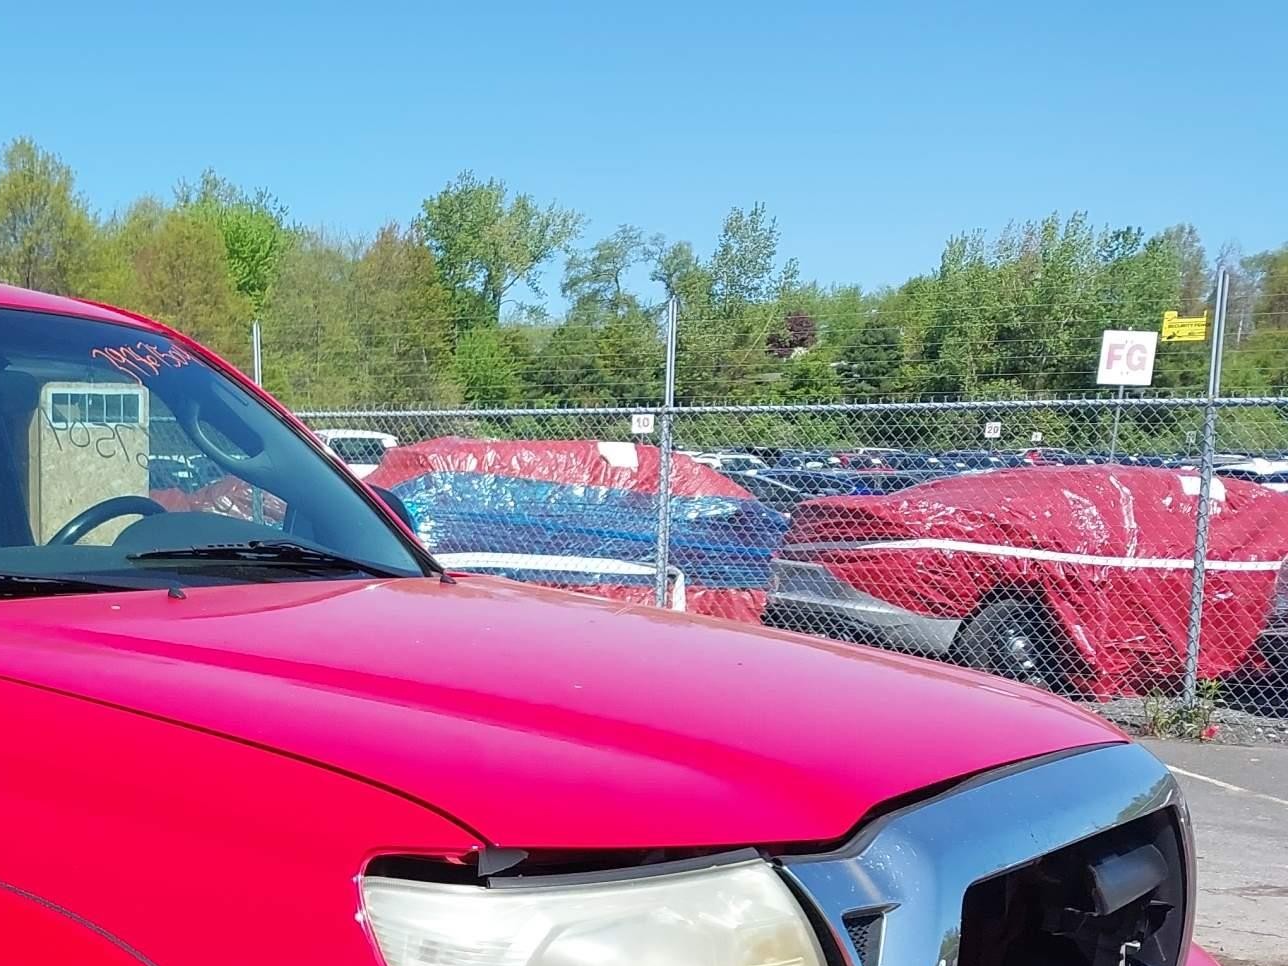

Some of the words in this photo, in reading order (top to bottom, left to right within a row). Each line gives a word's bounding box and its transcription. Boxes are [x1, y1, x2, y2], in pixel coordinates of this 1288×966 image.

[1105, 343, 1148, 372] FG
[636, 416, 650, 428] 10
[987, 425, 1000, 434] 20
